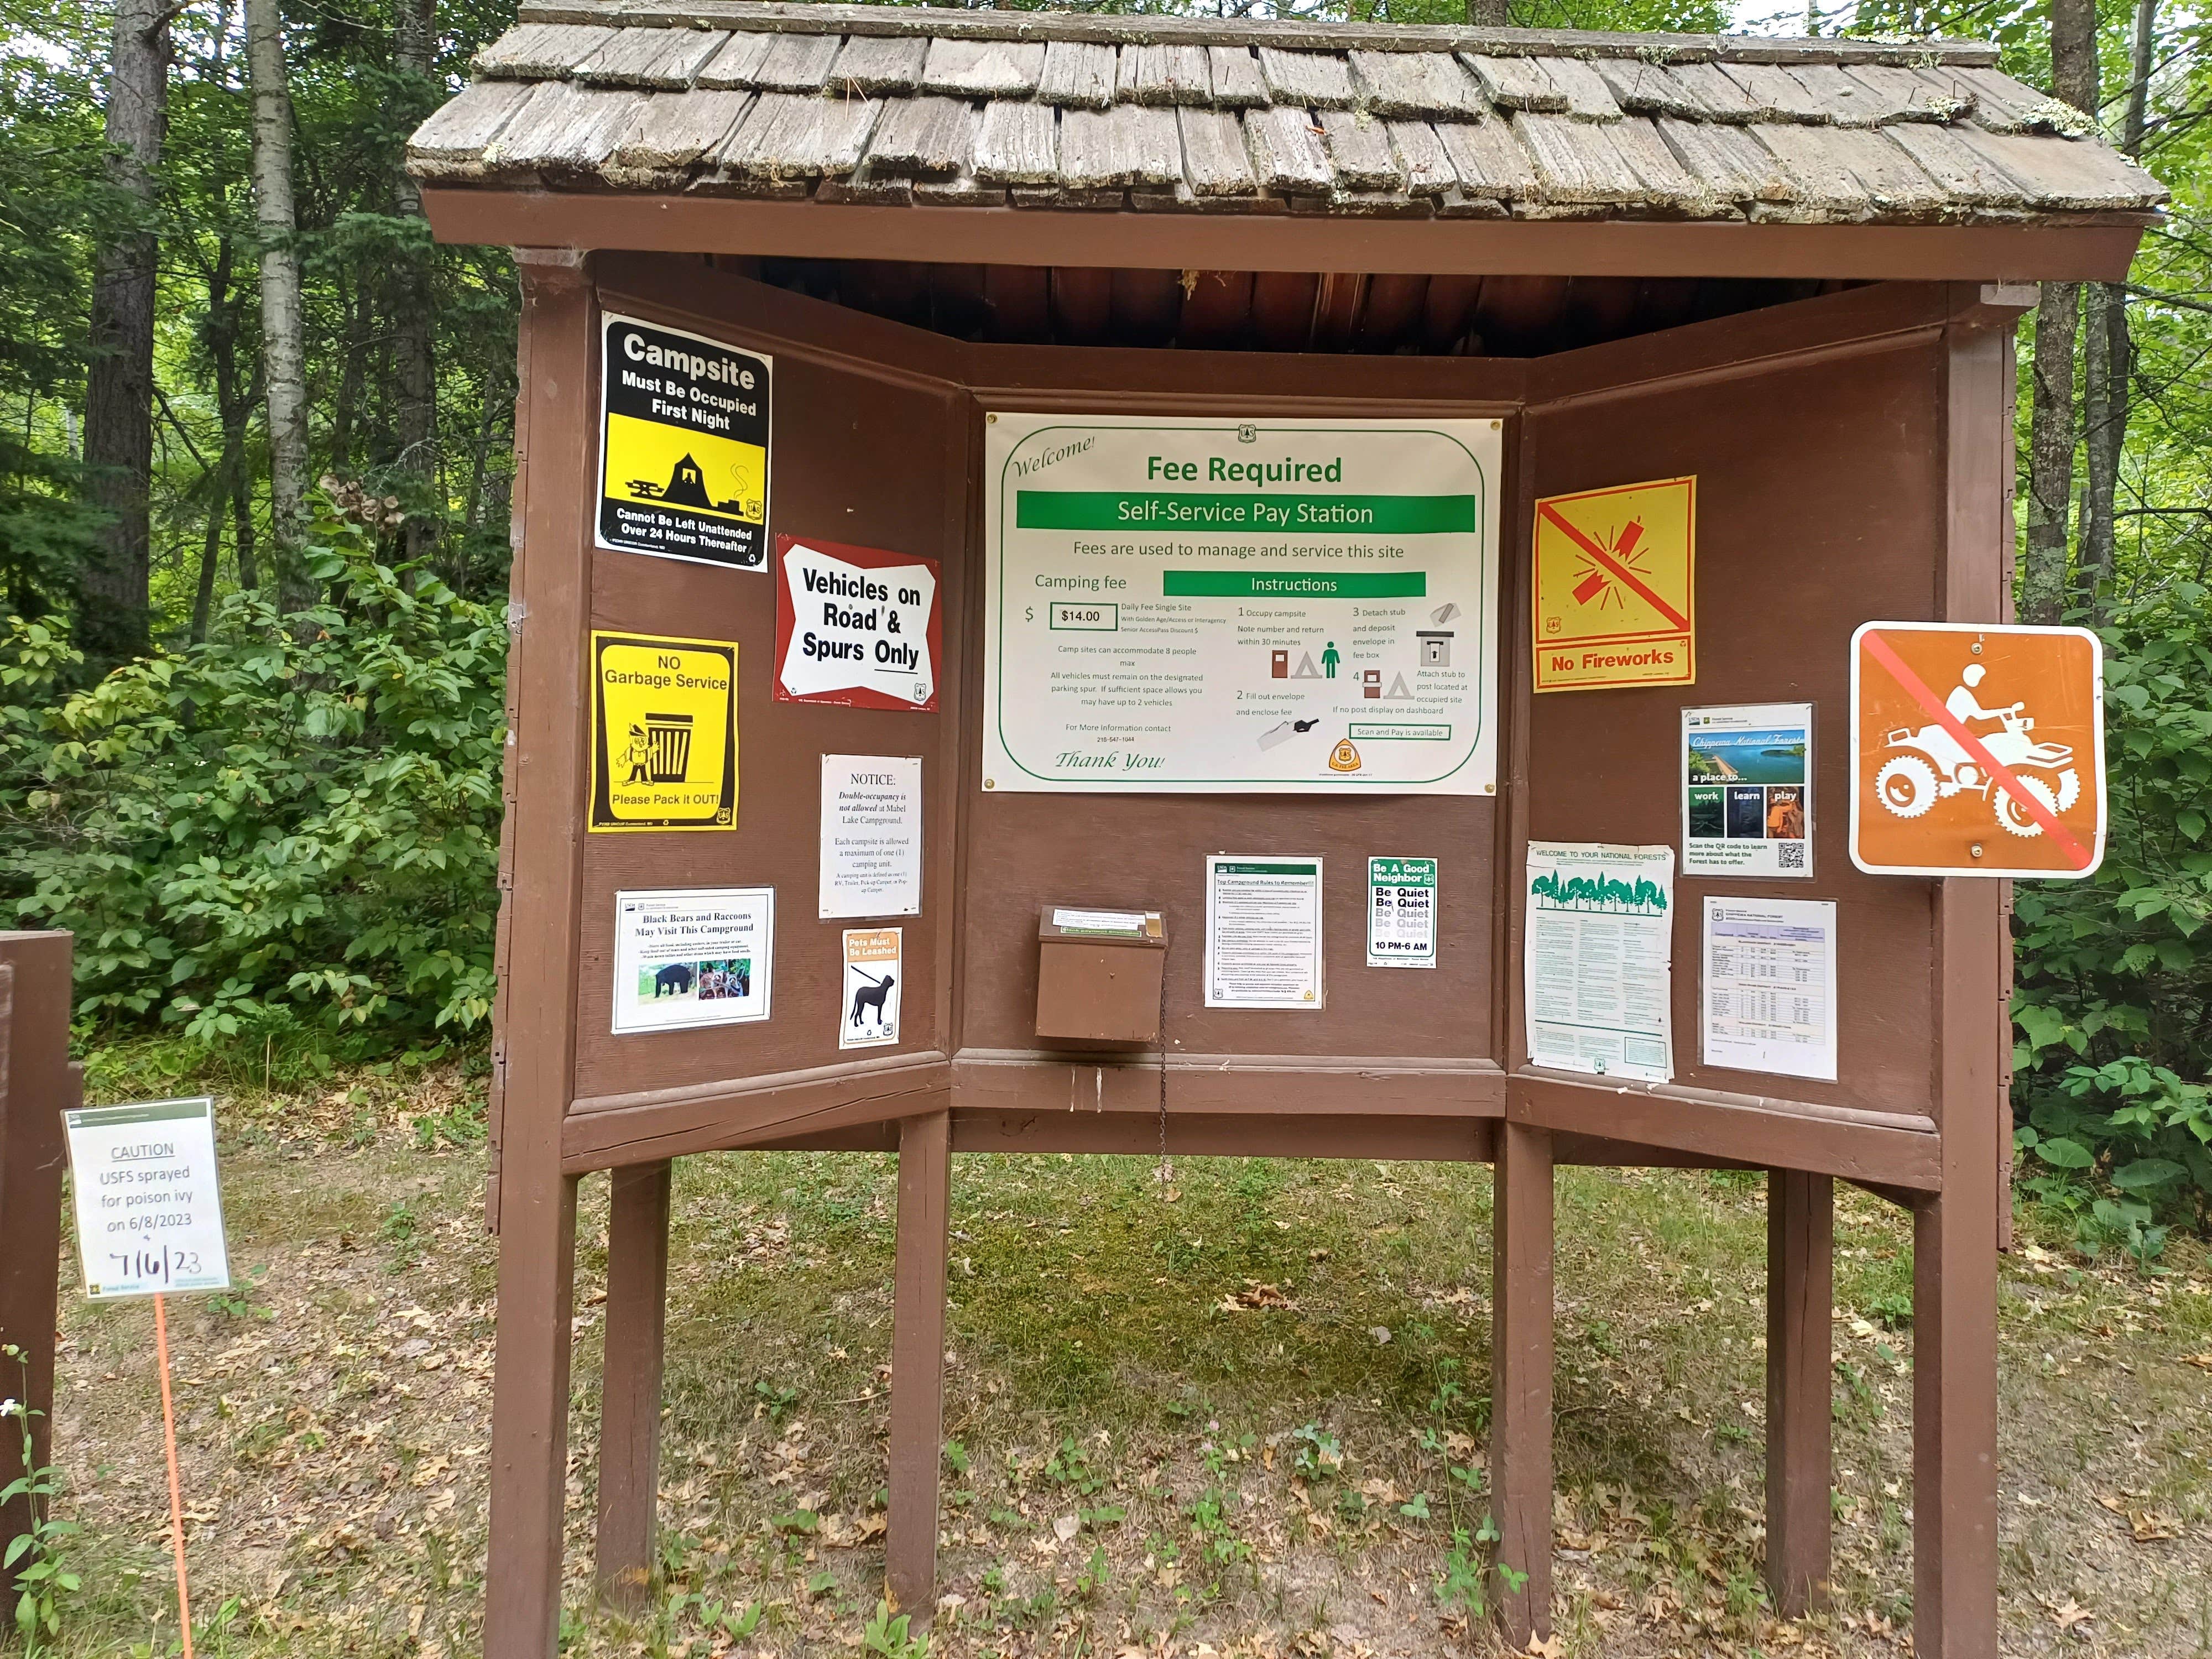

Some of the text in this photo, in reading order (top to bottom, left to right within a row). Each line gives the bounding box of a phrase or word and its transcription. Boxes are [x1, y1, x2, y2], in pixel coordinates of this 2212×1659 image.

[624, 333, 755, 389] Campsite
[623, 370, 756, 416] Must Be Occupied
[653, 398, 729, 430] First Night
[1012, 436, 1095, 478] Welcome!
[1148, 456, 1342, 487] Fee Required
[1118, 499, 1373, 526] Self-Service Pay Station
[617, 508, 752, 540] Cannot Be Left Unattended
[622, 523, 646, 537] Over
[650, 529, 662, 539] 24
[666, 531, 696, 544] Hours
[699, 535, 747, 552] Thereafter
[1074, 541, 1404, 559] Fees are used to manage and service this site
[803, 567, 920, 606] Vehicles on
[1035, 575, 1126, 591] Camping fee
[1252, 578, 1337, 592] Instructions
[1025, 607, 1099, 622] $ $14.00
[1121, 603, 1139, 612] Daily
[1239, 607, 1244, 615] 1
[1354, 607, 1359, 616] 3
[824, 602, 901, 633] Road &
[803, 632, 919, 670] Spurs Only
[658, 655, 681, 670] NO
[1552, 649, 1673, 671] No Fireworks
[605, 669, 727, 690] Garbage Service
[1353, 672, 1359, 681] 4
[1237, 691, 1243, 699] 2
[1734, 735, 1772, 745] National
[1772, 734, 1801, 744] Forest
[1055, 751, 1165, 771] Thank You!
[851, 774, 895, 785] NOTICE:
[1700, 773, 1726, 782] place
[613, 794, 650, 804] Please
[654, 795, 680, 804] Pack
[693, 795, 719, 804] OUT!
[839, 792, 899, 802] Double-occupancy
[1694, 791, 1718, 800] work
[1734, 791, 1760, 800] learn
[1775, 791, 1796, 801] play
[860, 816, 902, 825] Campground.
[1374, 864, 1429, 873] Be A Good
[1374, 873, 1422, 884] Neighbor
[1376, 888, 1429, 897] Be Quiet
[1376, 898, 1429, 907] Be Quiet
[643, 915, 667, 924] Black
[670, 914, 693, 922] Bears
[696, 913, 711, 921] and
[635, 924, 753, 937] May Visit This Campground
[849, 937, 890, 947] Pets Must
[849, 947, 896, 956] Be Leashed
[111, 1143, 174, 1159] CAUTION
[100, 1166, 189, 1185] USFS sprayed
[102, 1190, 192, 1208] for poison ivy
[107, 1213, 191, 1232] on 6/8/2023
